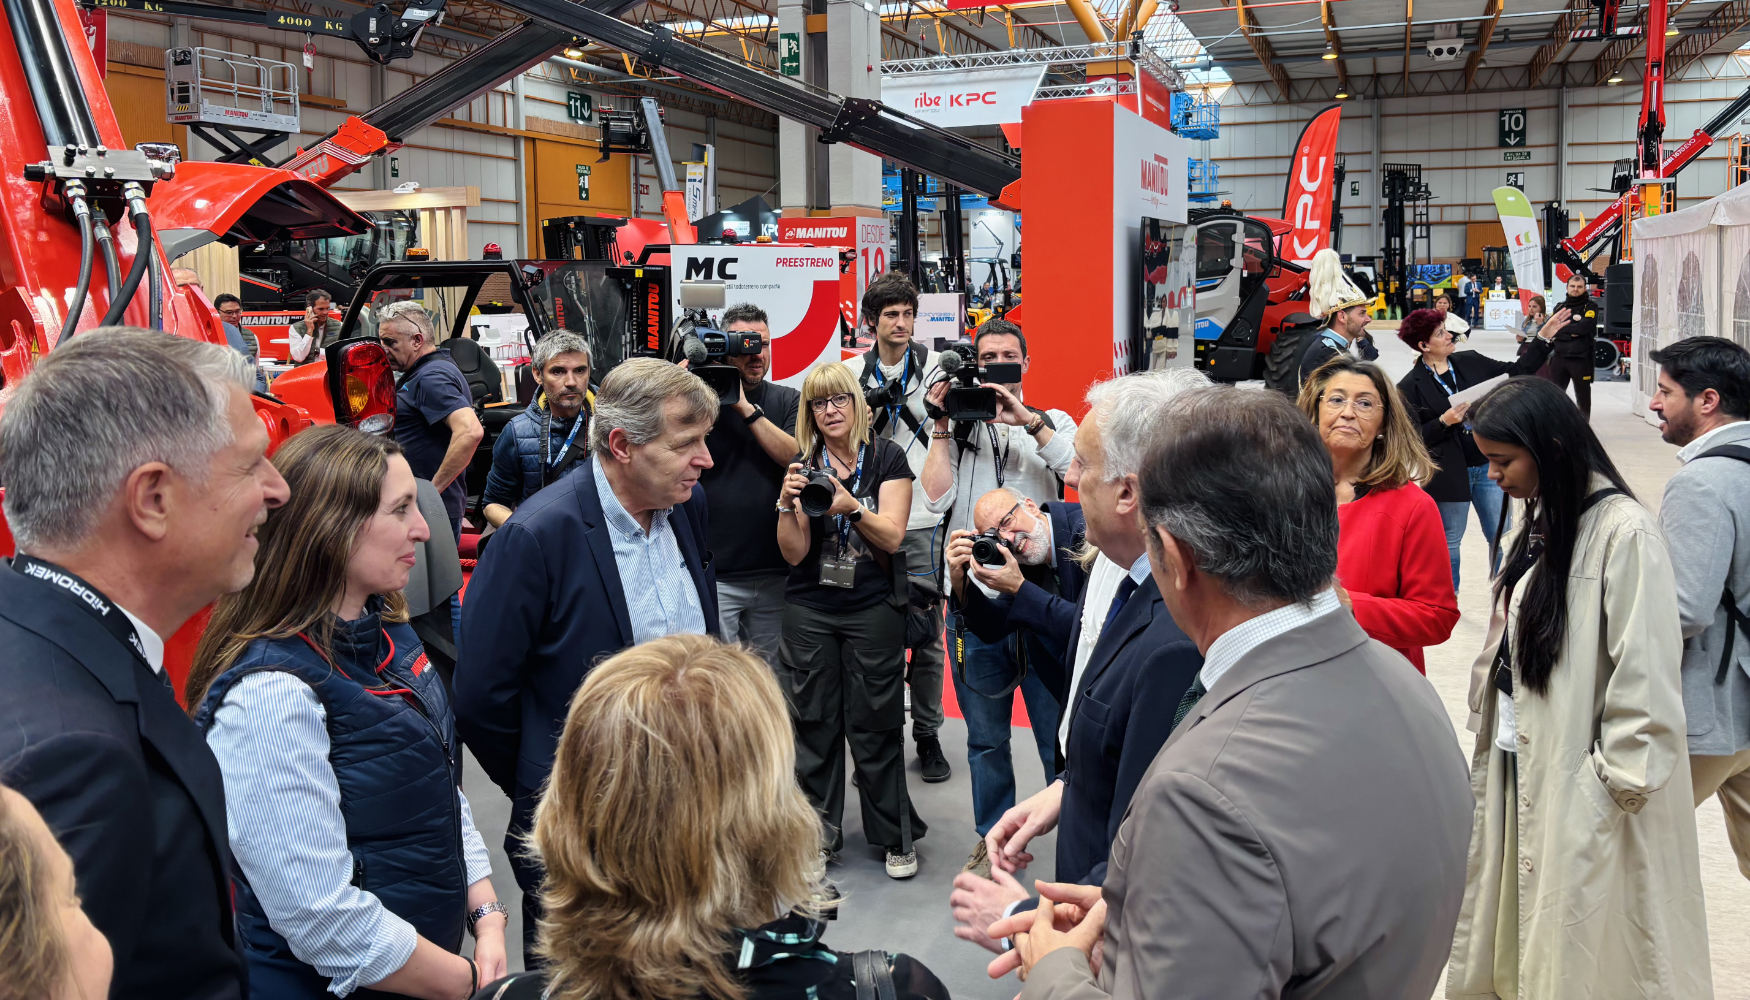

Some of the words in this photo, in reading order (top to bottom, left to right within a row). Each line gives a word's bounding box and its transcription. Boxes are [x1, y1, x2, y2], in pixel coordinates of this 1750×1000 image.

[144, 1, 163, 11] KG
[278, 15, 312, 27] 4000
[325, 20, 343, 31] KG
[914, 92, 942, 108] ribe
[949, 91, 997, 107] KPC
[224, 109, 249, 118] MANITOU
[569, 98, 581, 118] 11
[1500, 113, 1524, 132] 10
[301, 153, 330, 179] TOU
[1291, 156, 1327, 270] KPC
[761, 223, 779, 237] KP
[795, 227, 847, 239] MANITOU
[861, 224, 885, 244] DESDE
[685, 257, 738, 280] MC
[776, 257, 834, 268] PREESTRENO
[241, 315, 290, 325] MANITOU
[647, 283, 660, 350] MANITOU
[1194, 320, 1210, 330] ITOU
